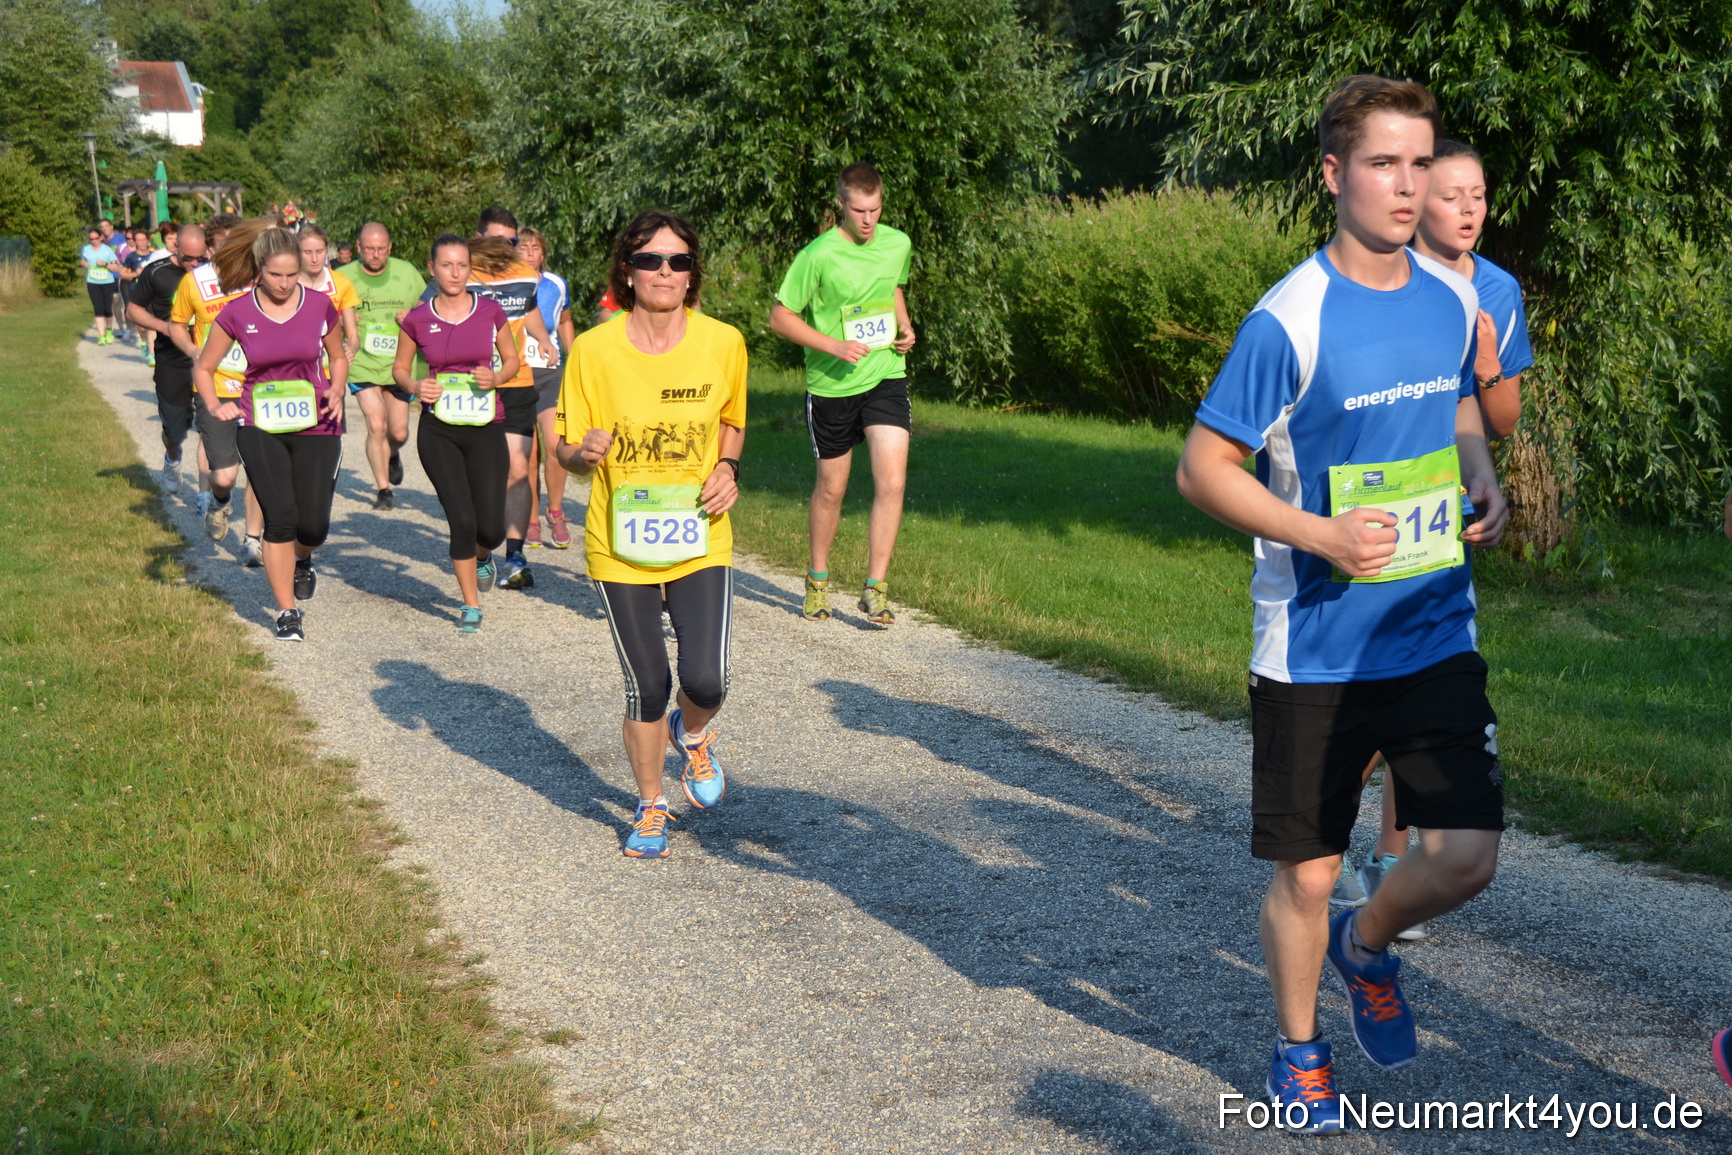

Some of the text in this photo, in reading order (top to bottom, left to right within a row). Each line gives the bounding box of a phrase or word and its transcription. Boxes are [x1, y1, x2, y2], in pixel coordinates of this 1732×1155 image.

[855, 319, 886, 339] 334
[373, 337, 396, 349] 652
[661, 388, 697, 399] swn
[261, 401, 310, 419] 1108
[443, 394, 489, 411] 1112
[624, 518, 699, 544] 1528
[1407, 550, 1428, 561] Frank
